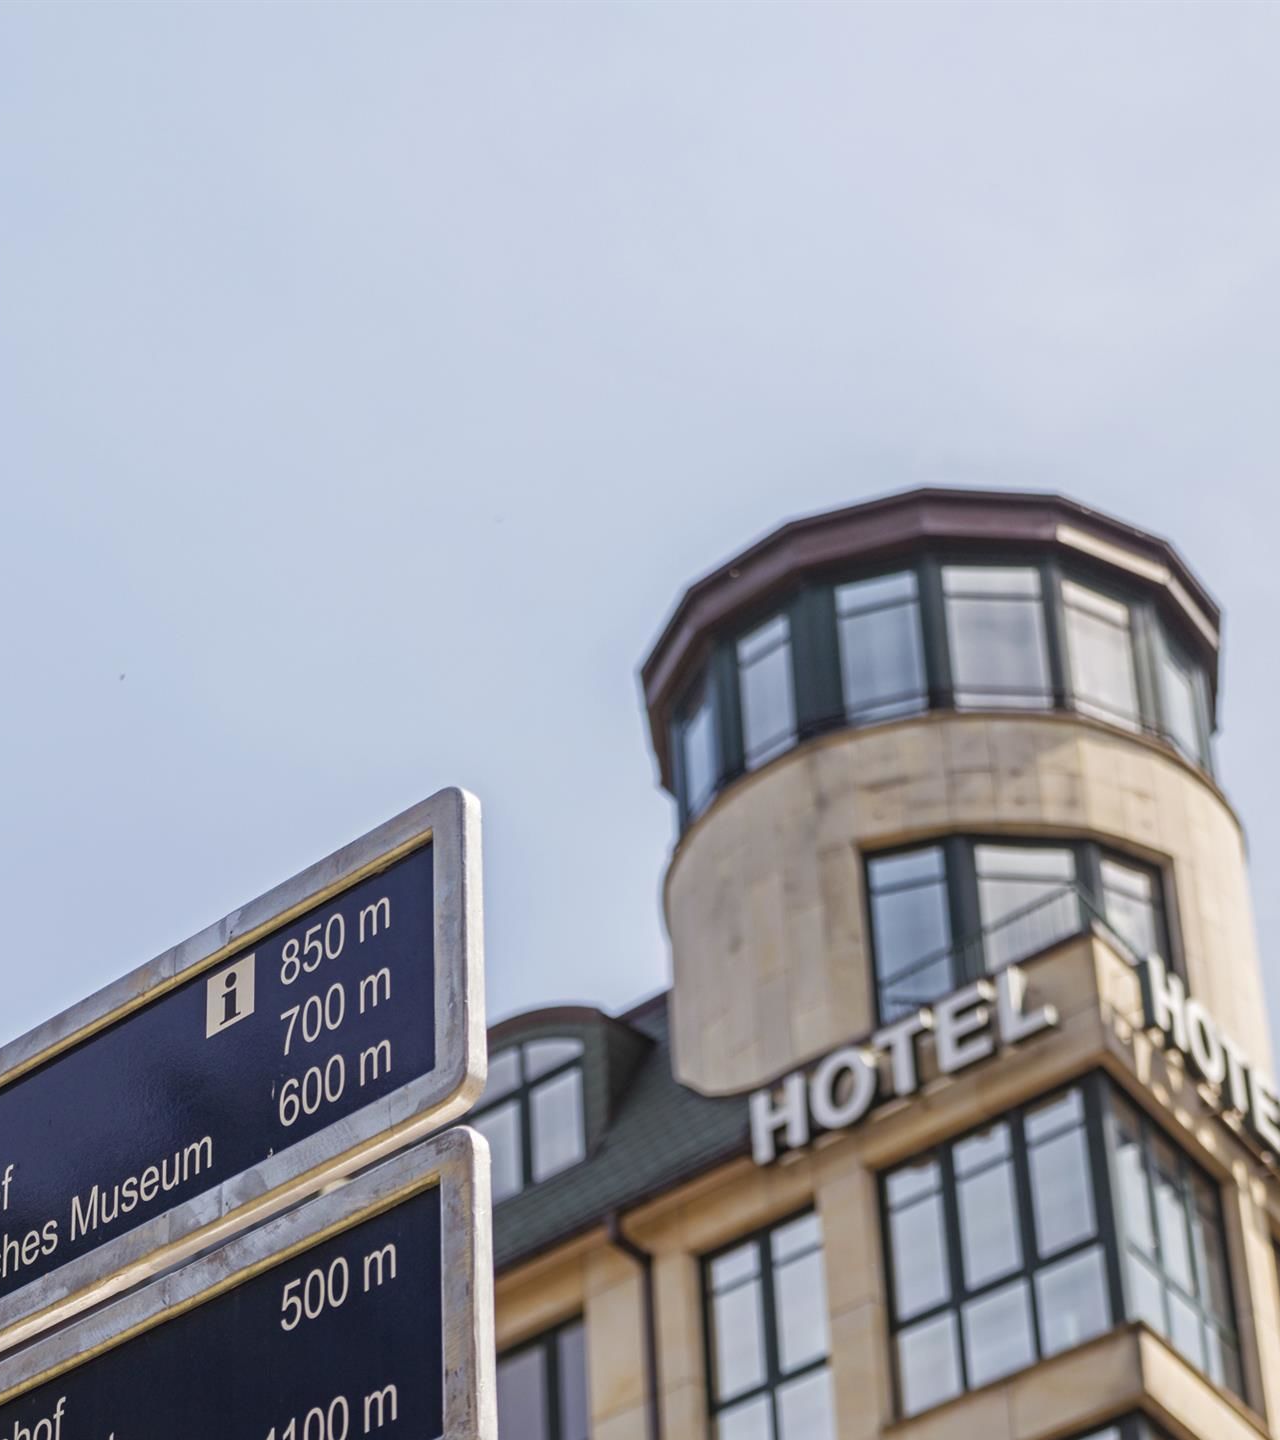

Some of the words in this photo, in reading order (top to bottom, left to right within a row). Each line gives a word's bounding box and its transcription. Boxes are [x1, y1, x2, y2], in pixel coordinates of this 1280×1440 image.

[280, 912, 345, 985] 850
[359, 896, 391, 943] m
[280, 982, 345, 1056] 700
[359, 967, 391, 1014] m
[750, 965, 1059, 1166] HOTEL
[70, 1135, 213, 1241] Museum
[279, 1053, 345, 1127] 600
[359, 1039, 392, 1087] m
[280, 1256, 349, 1331] 500
[364, 1243, 396, 1292] m
[364, 1384, 397, 1433] m
